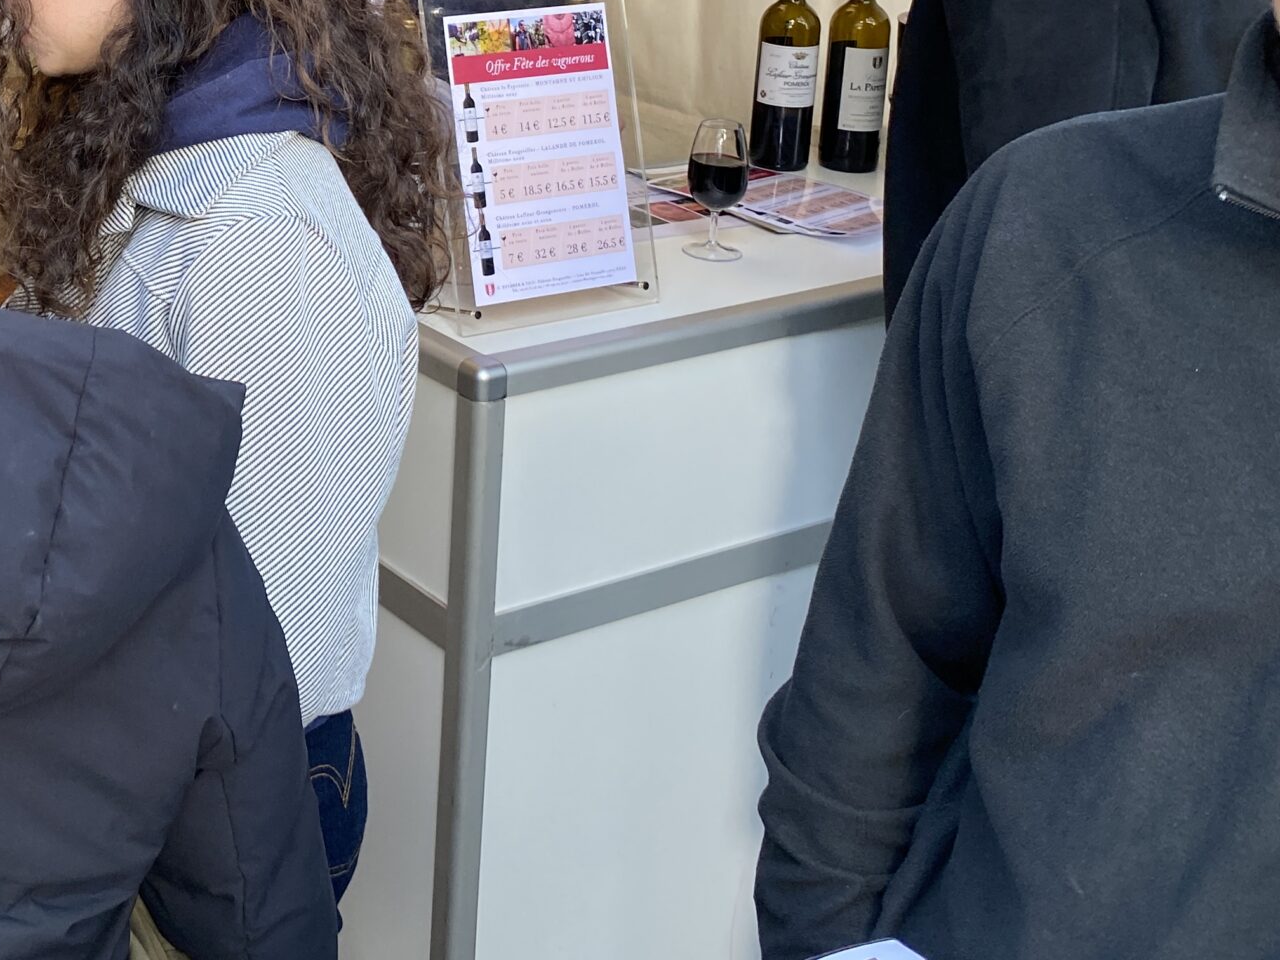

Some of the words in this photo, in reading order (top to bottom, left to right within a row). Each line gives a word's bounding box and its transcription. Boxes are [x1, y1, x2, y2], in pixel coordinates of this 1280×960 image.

[485, 59, 511, 76] Offre
[512, 57, 533, 71] Fête
[535, 55, 549, 68] des
[552, 54, 595, 70] vignerons
[547, 116, 567, 129] 12.5
[569, 115, 576, 126] €
[582, 113, 601, 125] 11.5
[604, 111, 610, 122] €
[501, 123, 507, 135] €
[519, 122, 530, 132] 14
[533, 120, 540, 131] €
[556, 180, 575, 192] 16.5
[578, 178, 584, 189] €
[589, 176, 609, 188] 15.5
[610, 174, 617, 185] €
[500, 189, 506, 200] 5
[508, 188, 515, 198] €
[523, 184, 543, 196] 18.5
[545, 182, 552, 193] €
[567, 243, 579, 255] 28
[581, 242, 588, 253] €
[597, 238, 617, 250] 26.5
[619, 236, 625, 247] €
[508, 253, 514, 263] 7
[517, 252, 524, 263] €
[535, 249, 547, 259] 32
[549, 247, 556, 258] €
